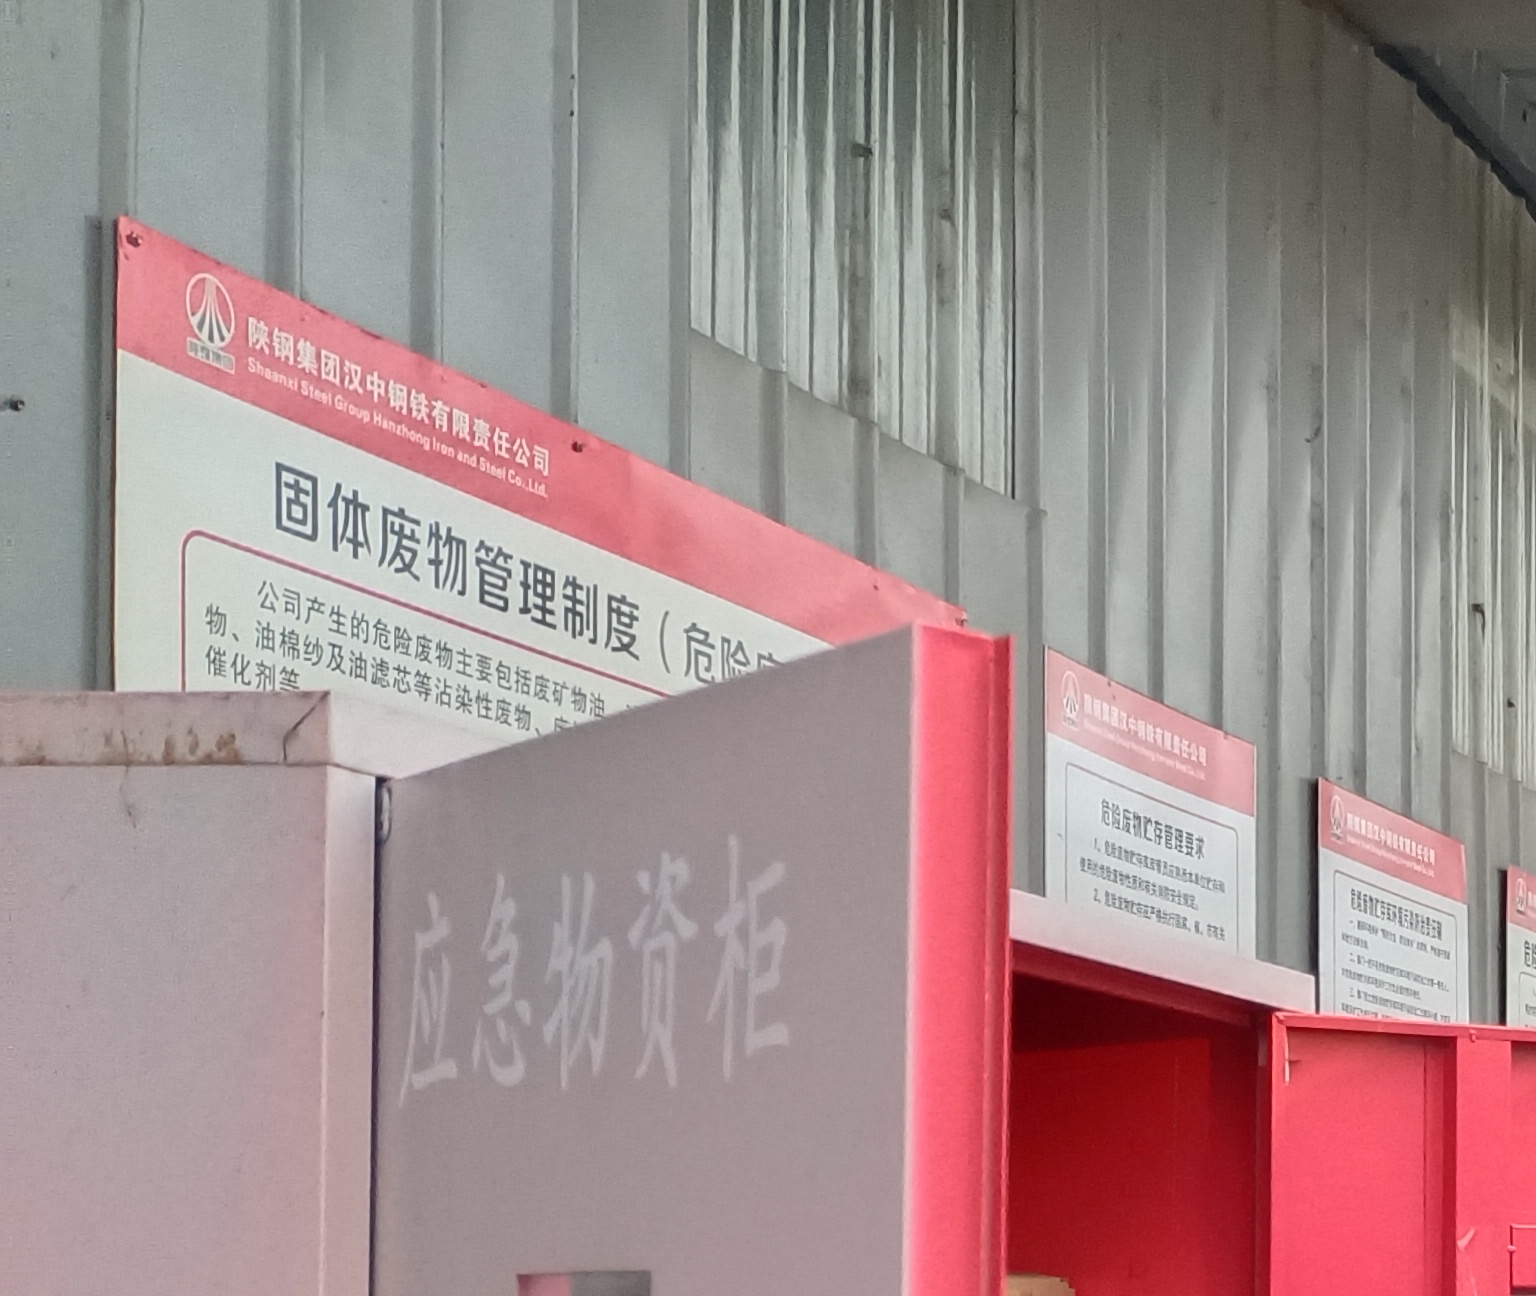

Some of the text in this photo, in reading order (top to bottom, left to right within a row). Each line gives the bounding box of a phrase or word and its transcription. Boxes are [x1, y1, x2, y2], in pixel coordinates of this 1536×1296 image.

[248, 316, 549, 477] 陕钢集团汉中钢铁有限责任公司
[248, 357, 298, 391] Shaanxi
[301, 380, 332, 406] Steel
[334, 394, 370, 424] Group
[373, 409, 431, 451] Hanzhong
[433, 436, 455, 457] Iron
[457, 449, 477, 468] and
[479, 457, 506, 481] Steel
[205, 603, 578, 737] 物、油棉纱及油滤芯等沾染性废物、
[257, 580, 635, 718] 公司产生的危险废物主要包括废矿物油
[1101, 798, 1205, 860] 危险废物贮存管理要求
[400, 834, 789, 1107] 应急物资柜
